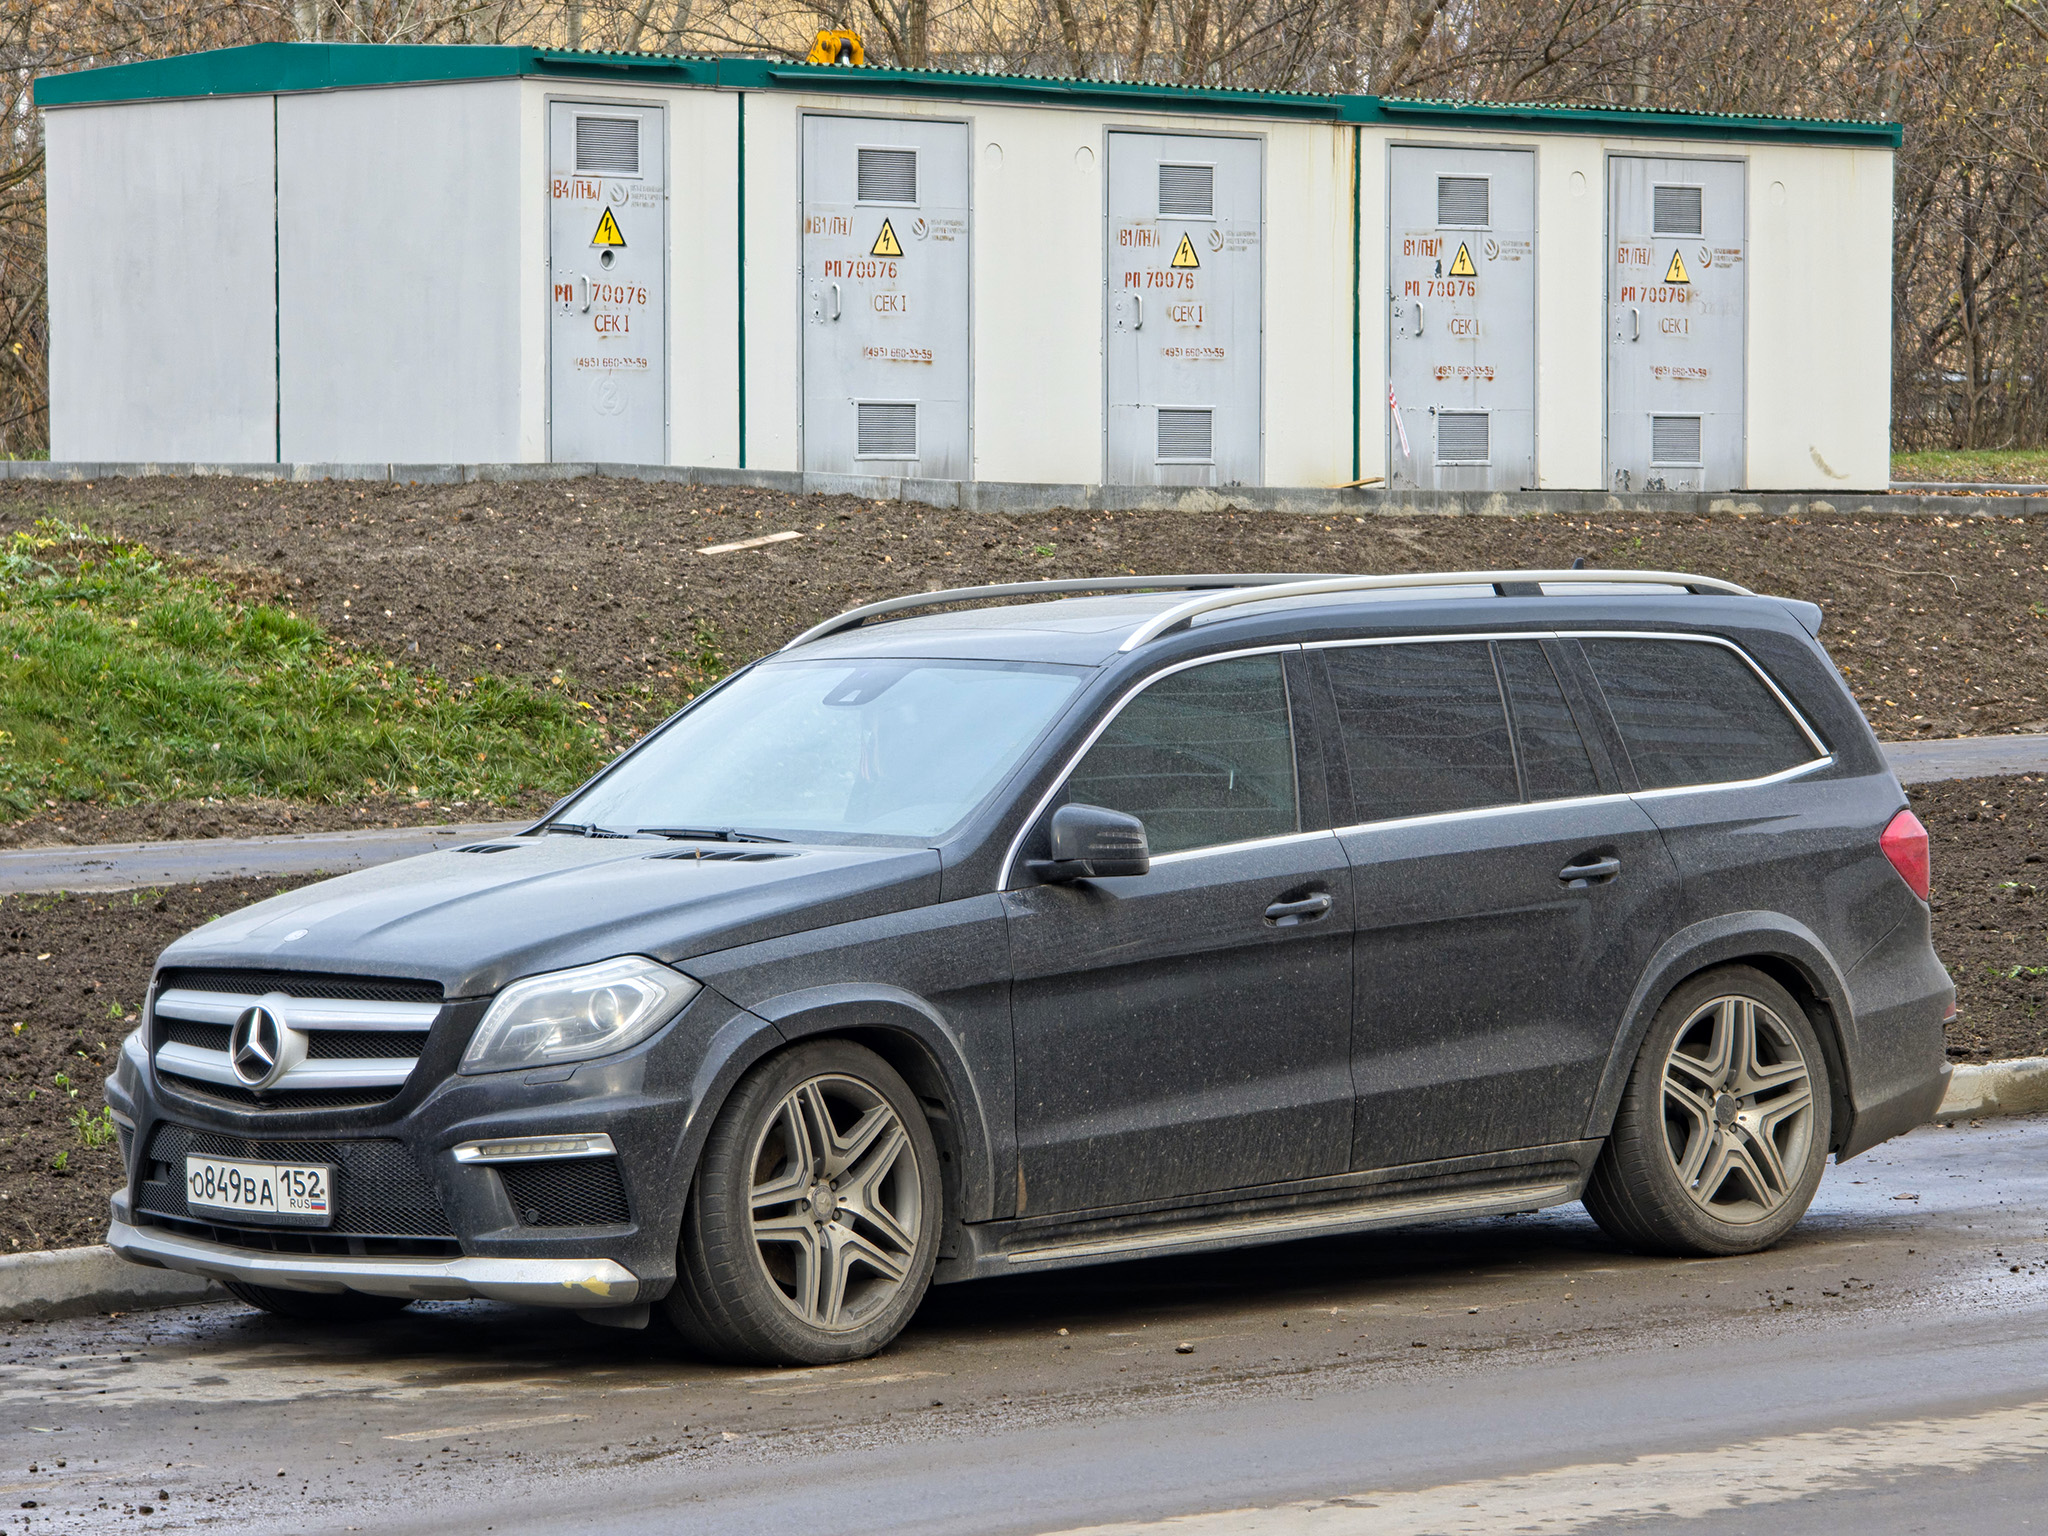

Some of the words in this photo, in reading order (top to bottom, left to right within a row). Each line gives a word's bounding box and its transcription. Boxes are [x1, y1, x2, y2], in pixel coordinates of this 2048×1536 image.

[825, 260, 842, 277] РП
[846, 260, 897, 278] 70076
[1125, 271, 1141, 288] РП
[1146, 271, 1194, 289] 70076
[1405, 280, 1420, 297] РП
[1427, 280, 1476, 297] 70076
[554, 284, 573, 302] РП
[592, 284, 647, 304] 70076
[1621, 286, 1636, 302] РП
[1640, 287, 1686, 303] 70076
[874, 295, 898, 312] СЕК
[1172, 305, 1195, 323] СЕК
[594, 314, 621, 332] СЕК
[1451, 318, 1472, 335] СЕК
[1661, 317, 1682, 334] СЕК
[280, 1169, 320, 1198] 152
[290, 1198, 311, 1209] RUS
